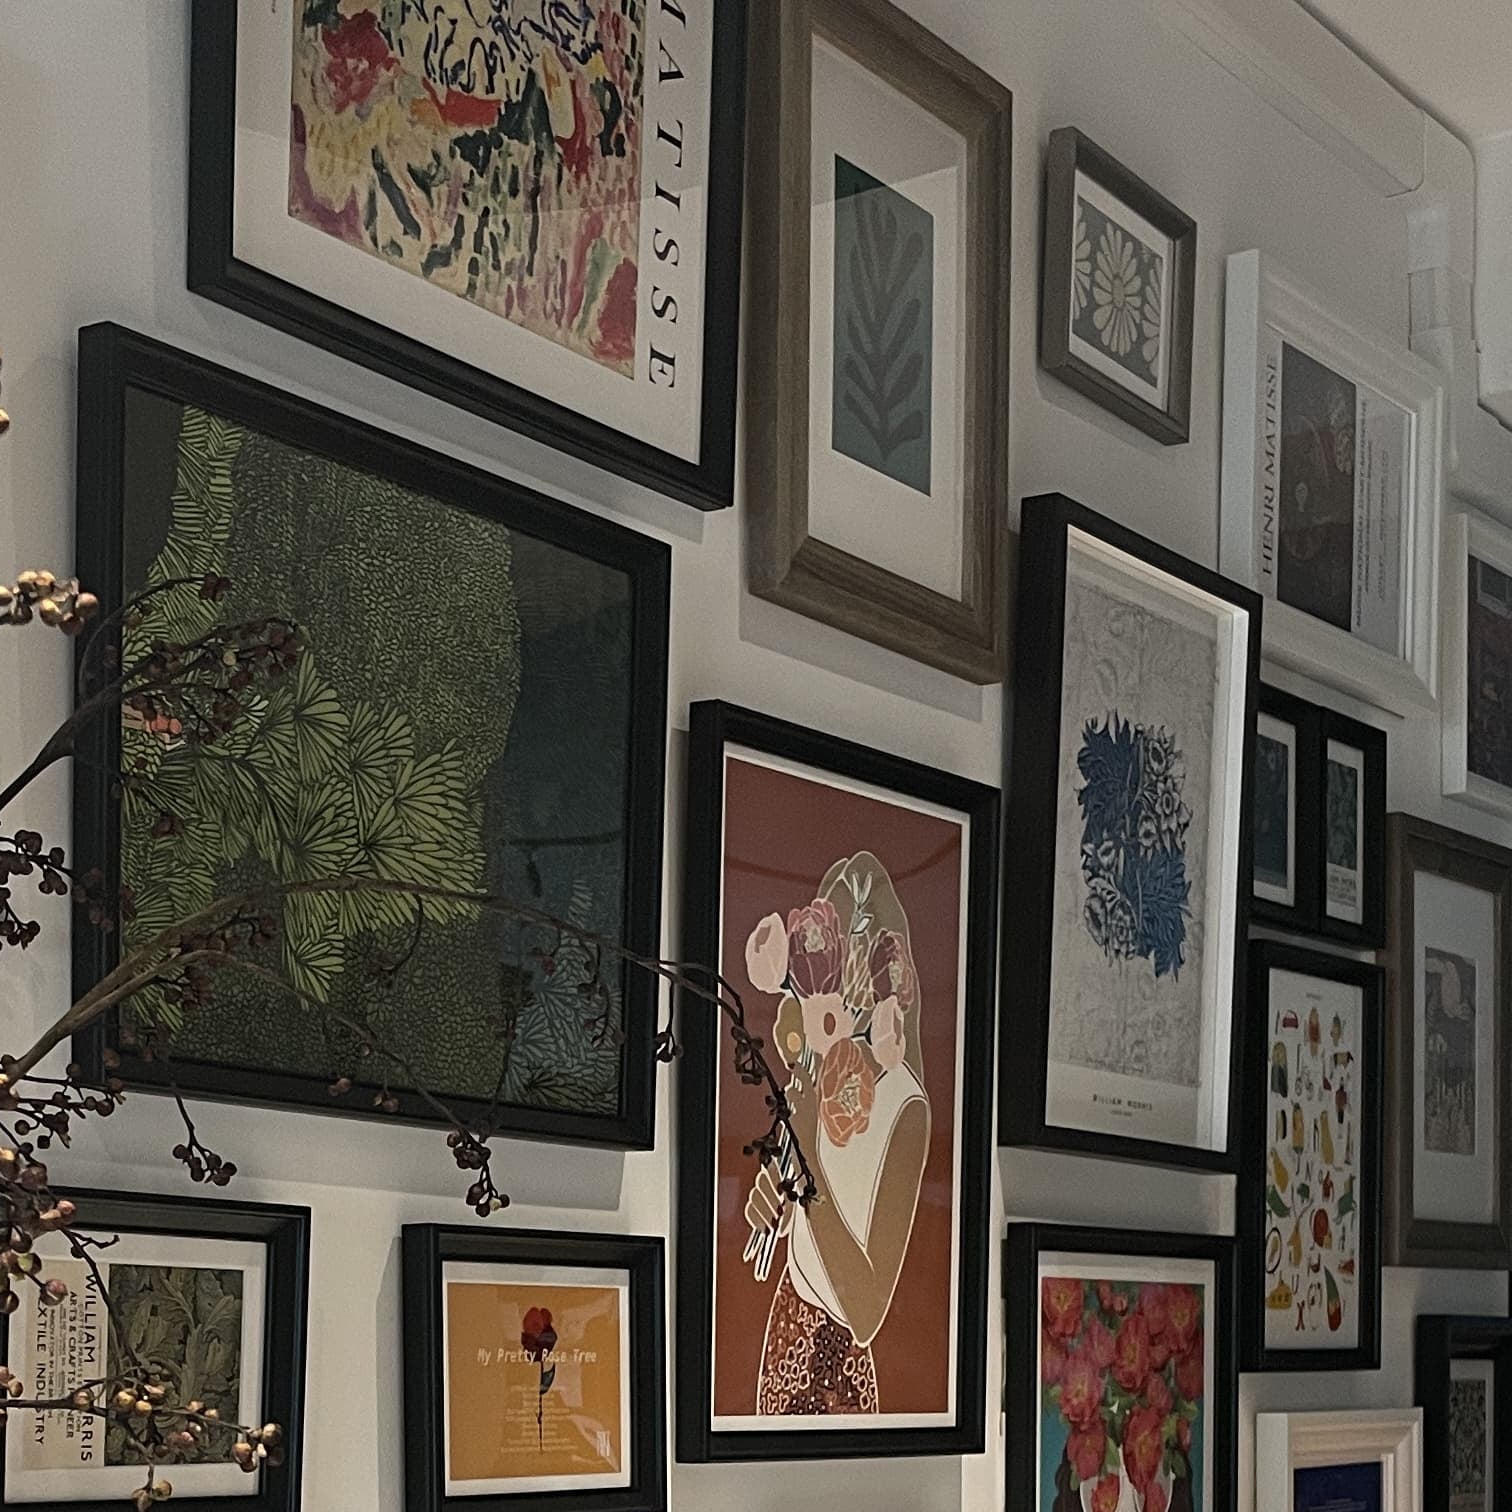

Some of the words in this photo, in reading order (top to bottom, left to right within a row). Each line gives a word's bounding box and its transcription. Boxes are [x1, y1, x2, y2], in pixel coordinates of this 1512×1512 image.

[1262, 486, 1274, 575] HENRI
[68, 1291, 78, 1322] ARTS
[85, 1274, 97, 1362] WILLIAM
[67, 1336, 77, 1386] CRAFTS
[477, 1347, 492, 1367] My
[497, 1347, 537, 1366] Pretty
[541, 1348, 567, 1363] Rose
[572, 1348, 597, 1364] Tree
